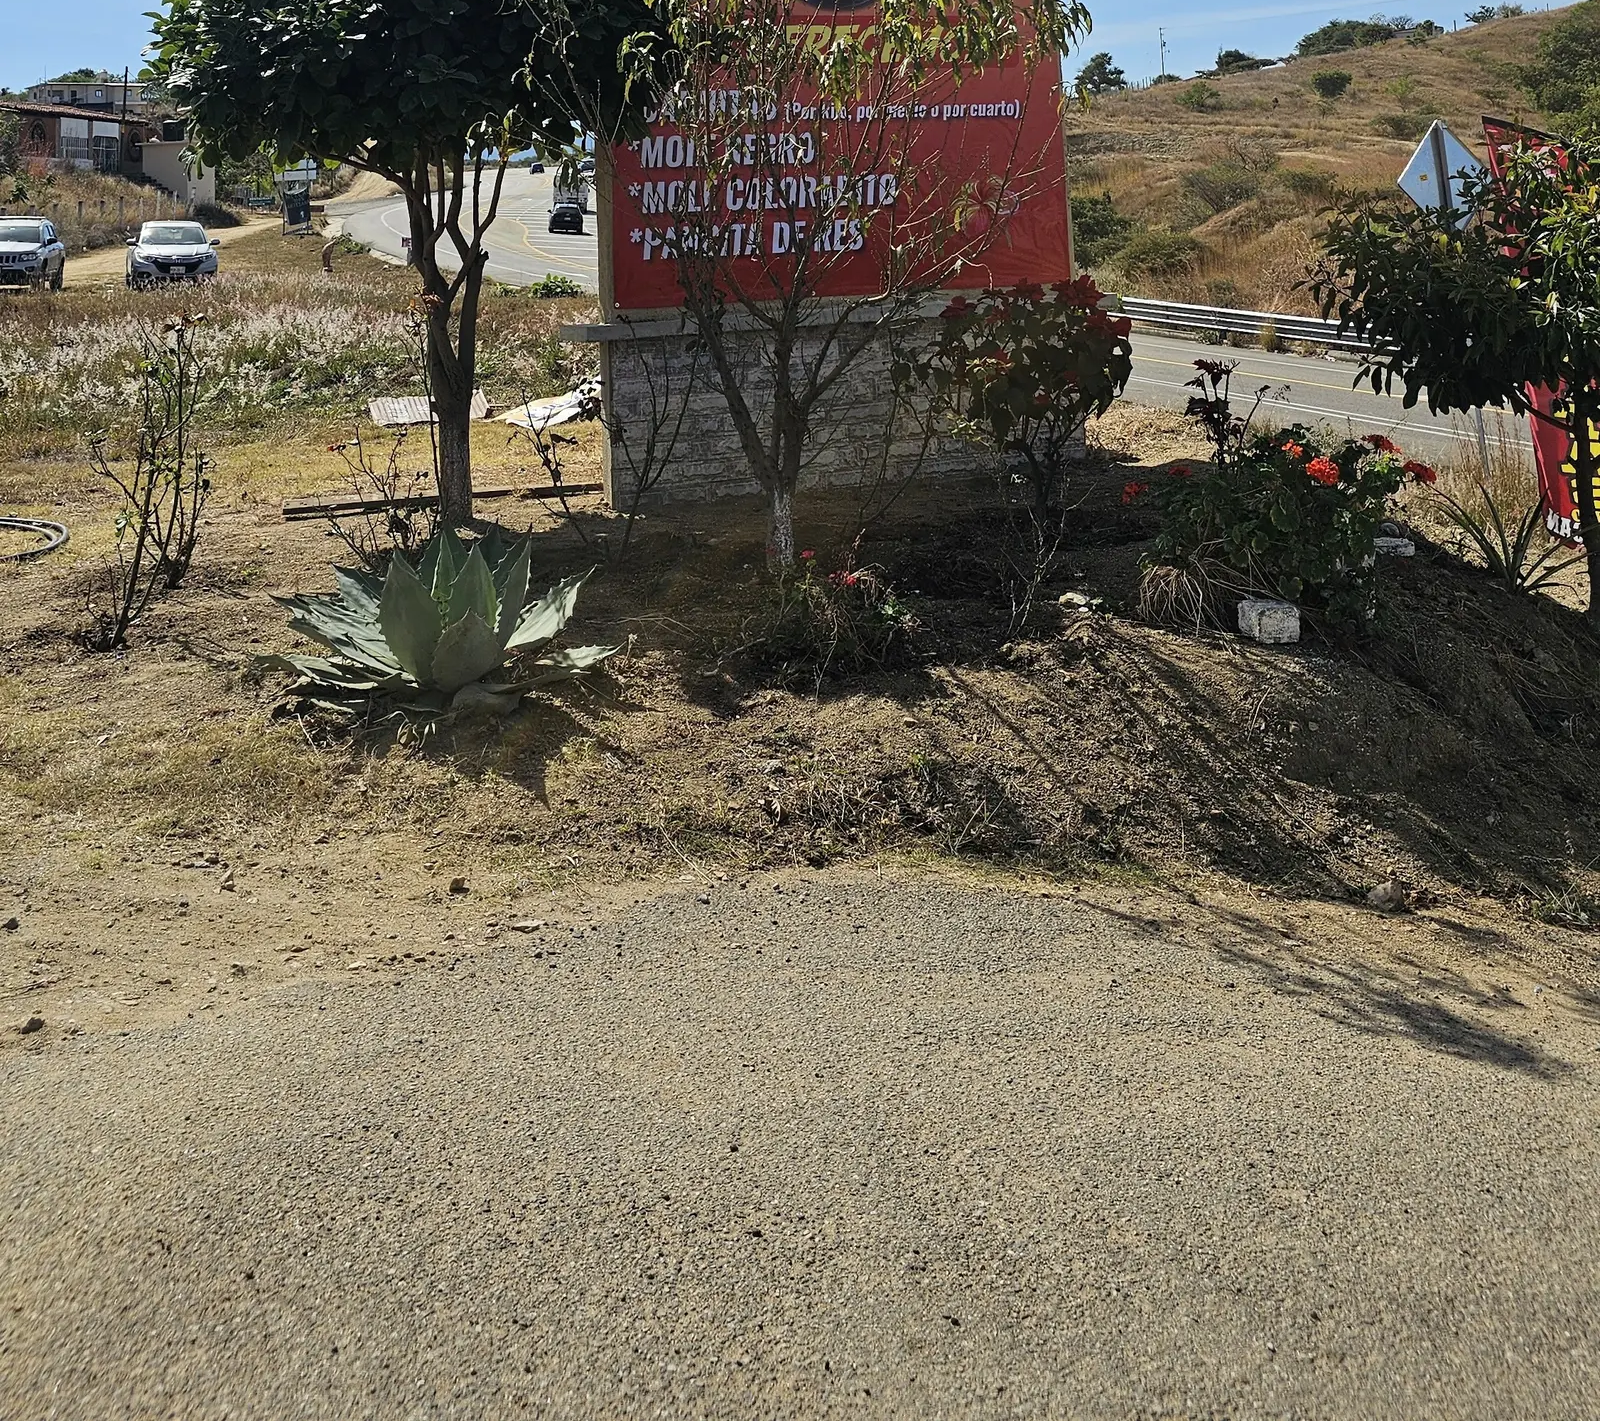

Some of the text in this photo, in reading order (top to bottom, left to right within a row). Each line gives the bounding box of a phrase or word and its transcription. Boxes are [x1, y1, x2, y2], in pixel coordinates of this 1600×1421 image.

[821, 102, 852, 122] kio,
[931, 105, 939, 117] o
[943, 103, 967, 120] por
[969, 99, 1020, 120] cuarto)
